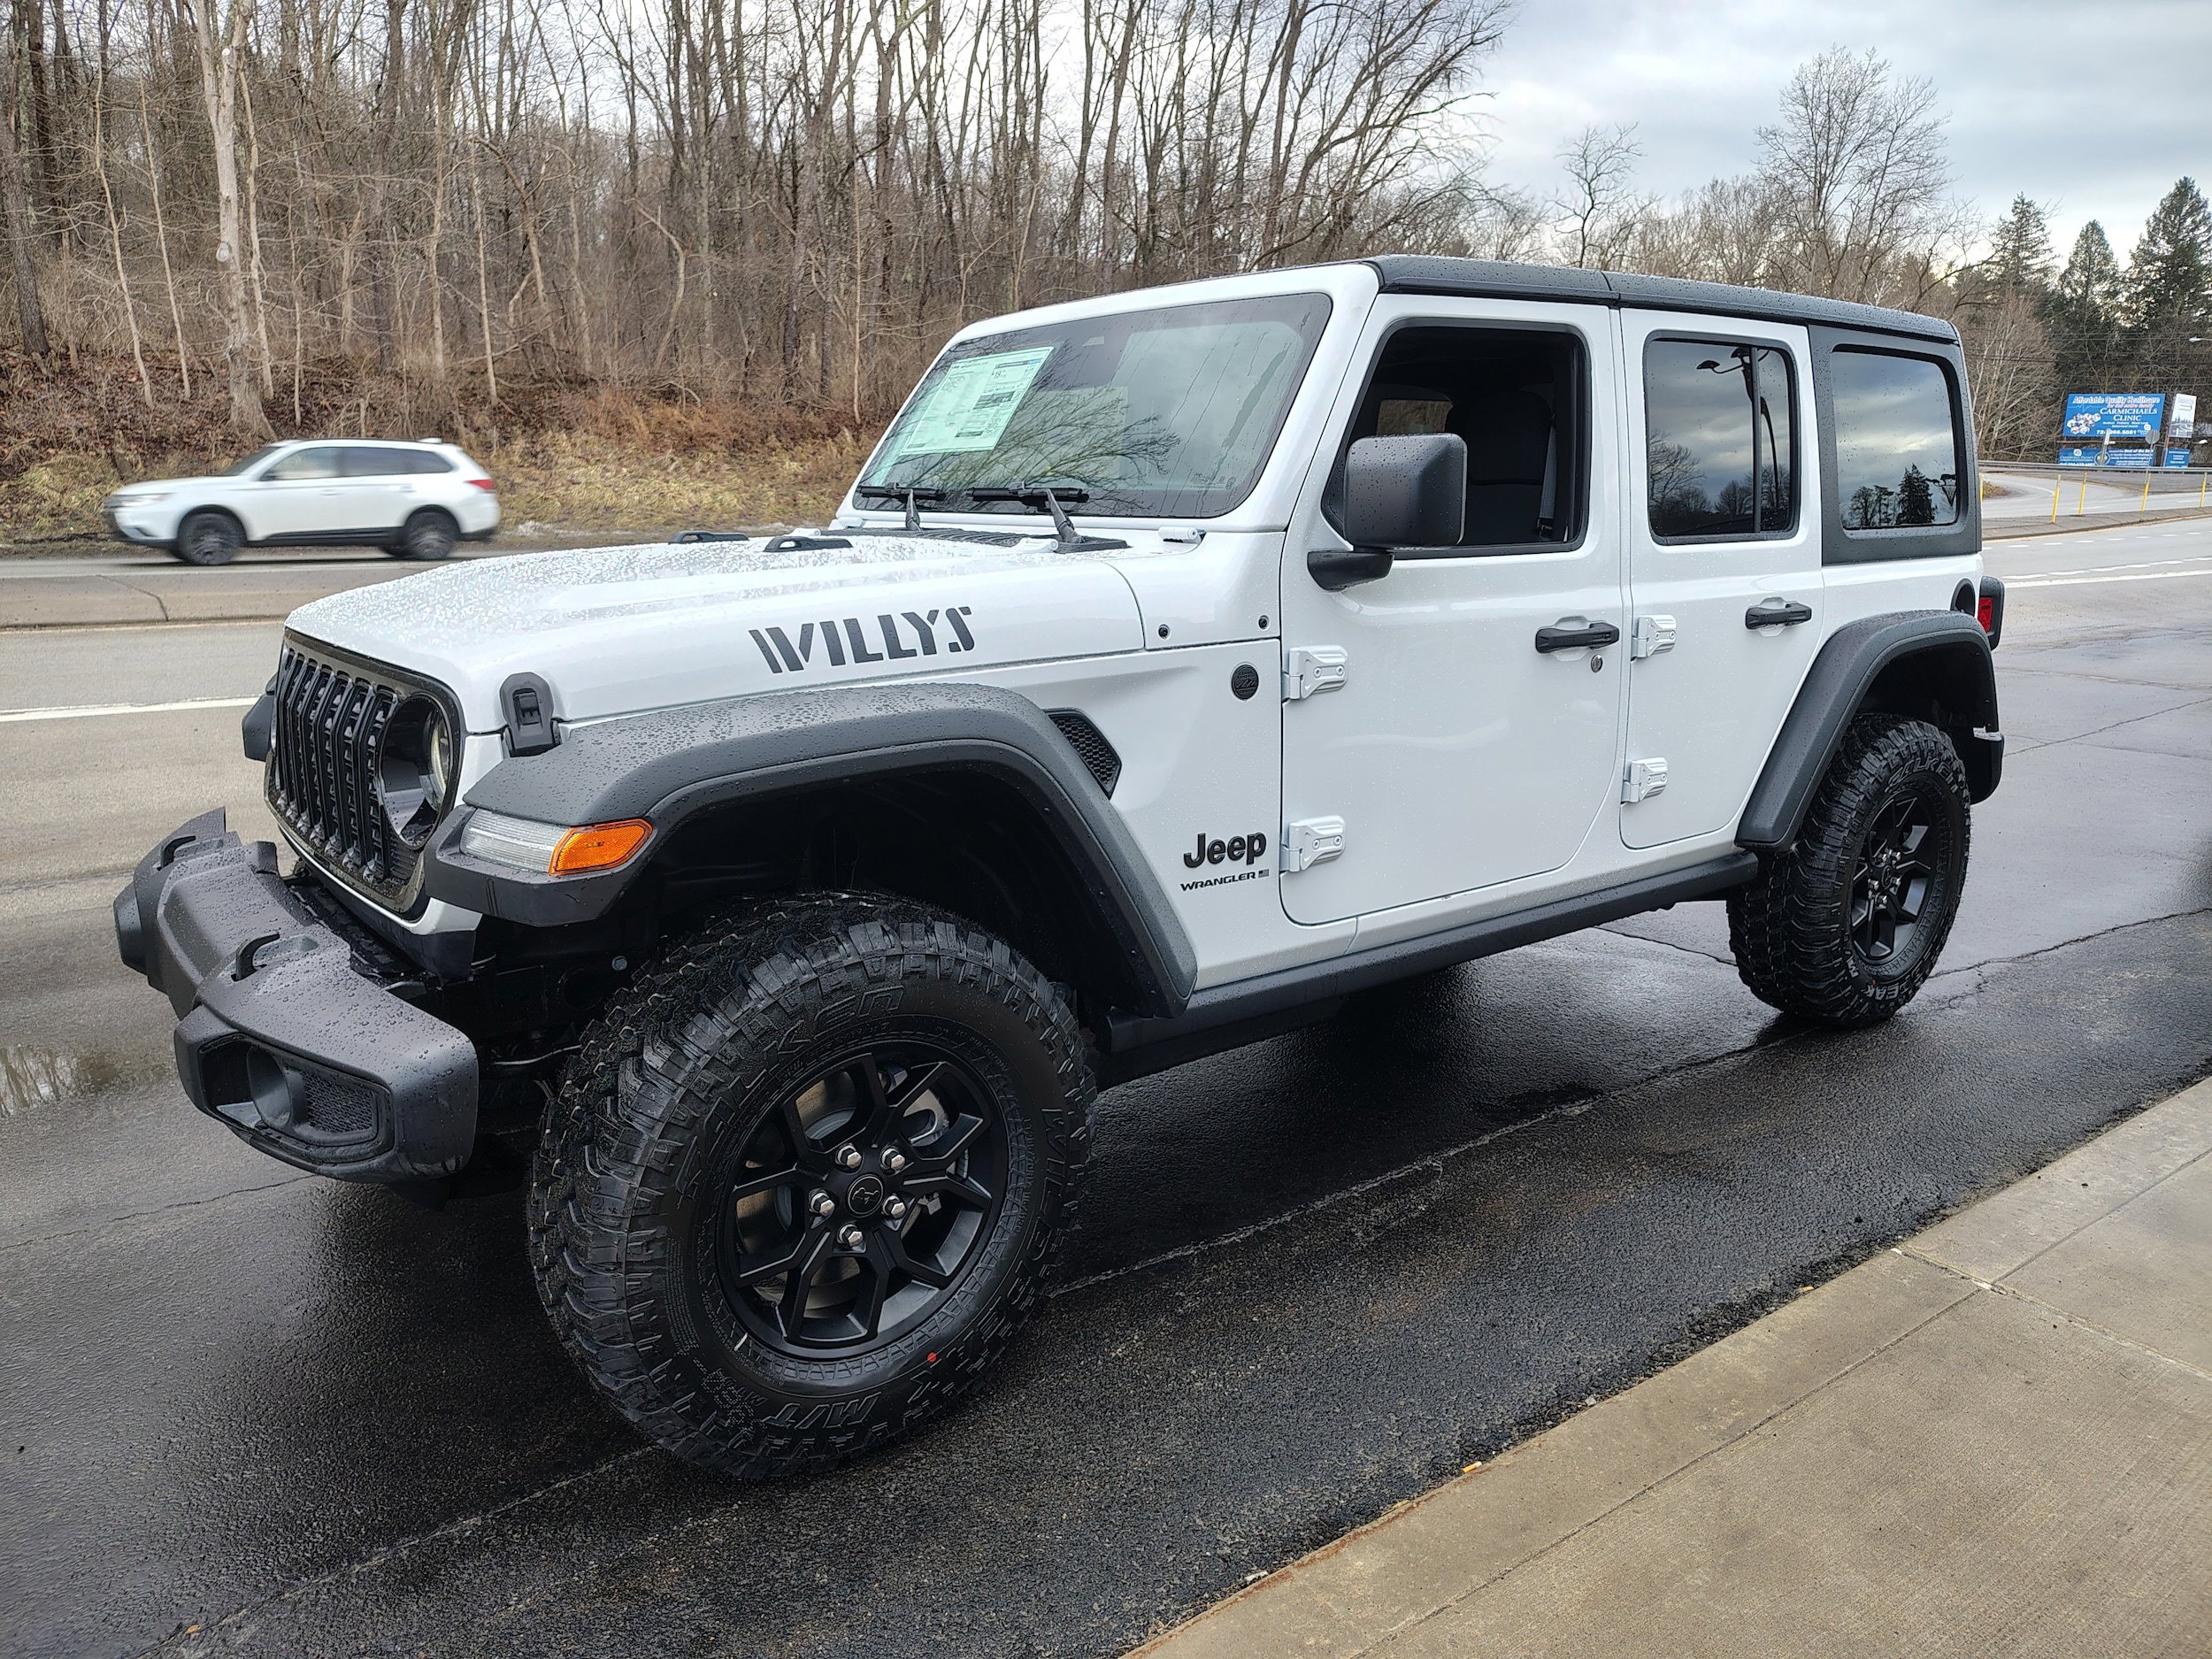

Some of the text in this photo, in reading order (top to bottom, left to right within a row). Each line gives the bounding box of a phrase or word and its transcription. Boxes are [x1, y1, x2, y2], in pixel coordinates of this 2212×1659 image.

[2105, 396, 2127, 404] Quality
[748, 606, 975, 673] WILLYS
[1183, 832, 1267, 868] Jeep
[1179, 872, 1256, 892] WRANGLER
[761, 1391, 882, 1430] M/T
